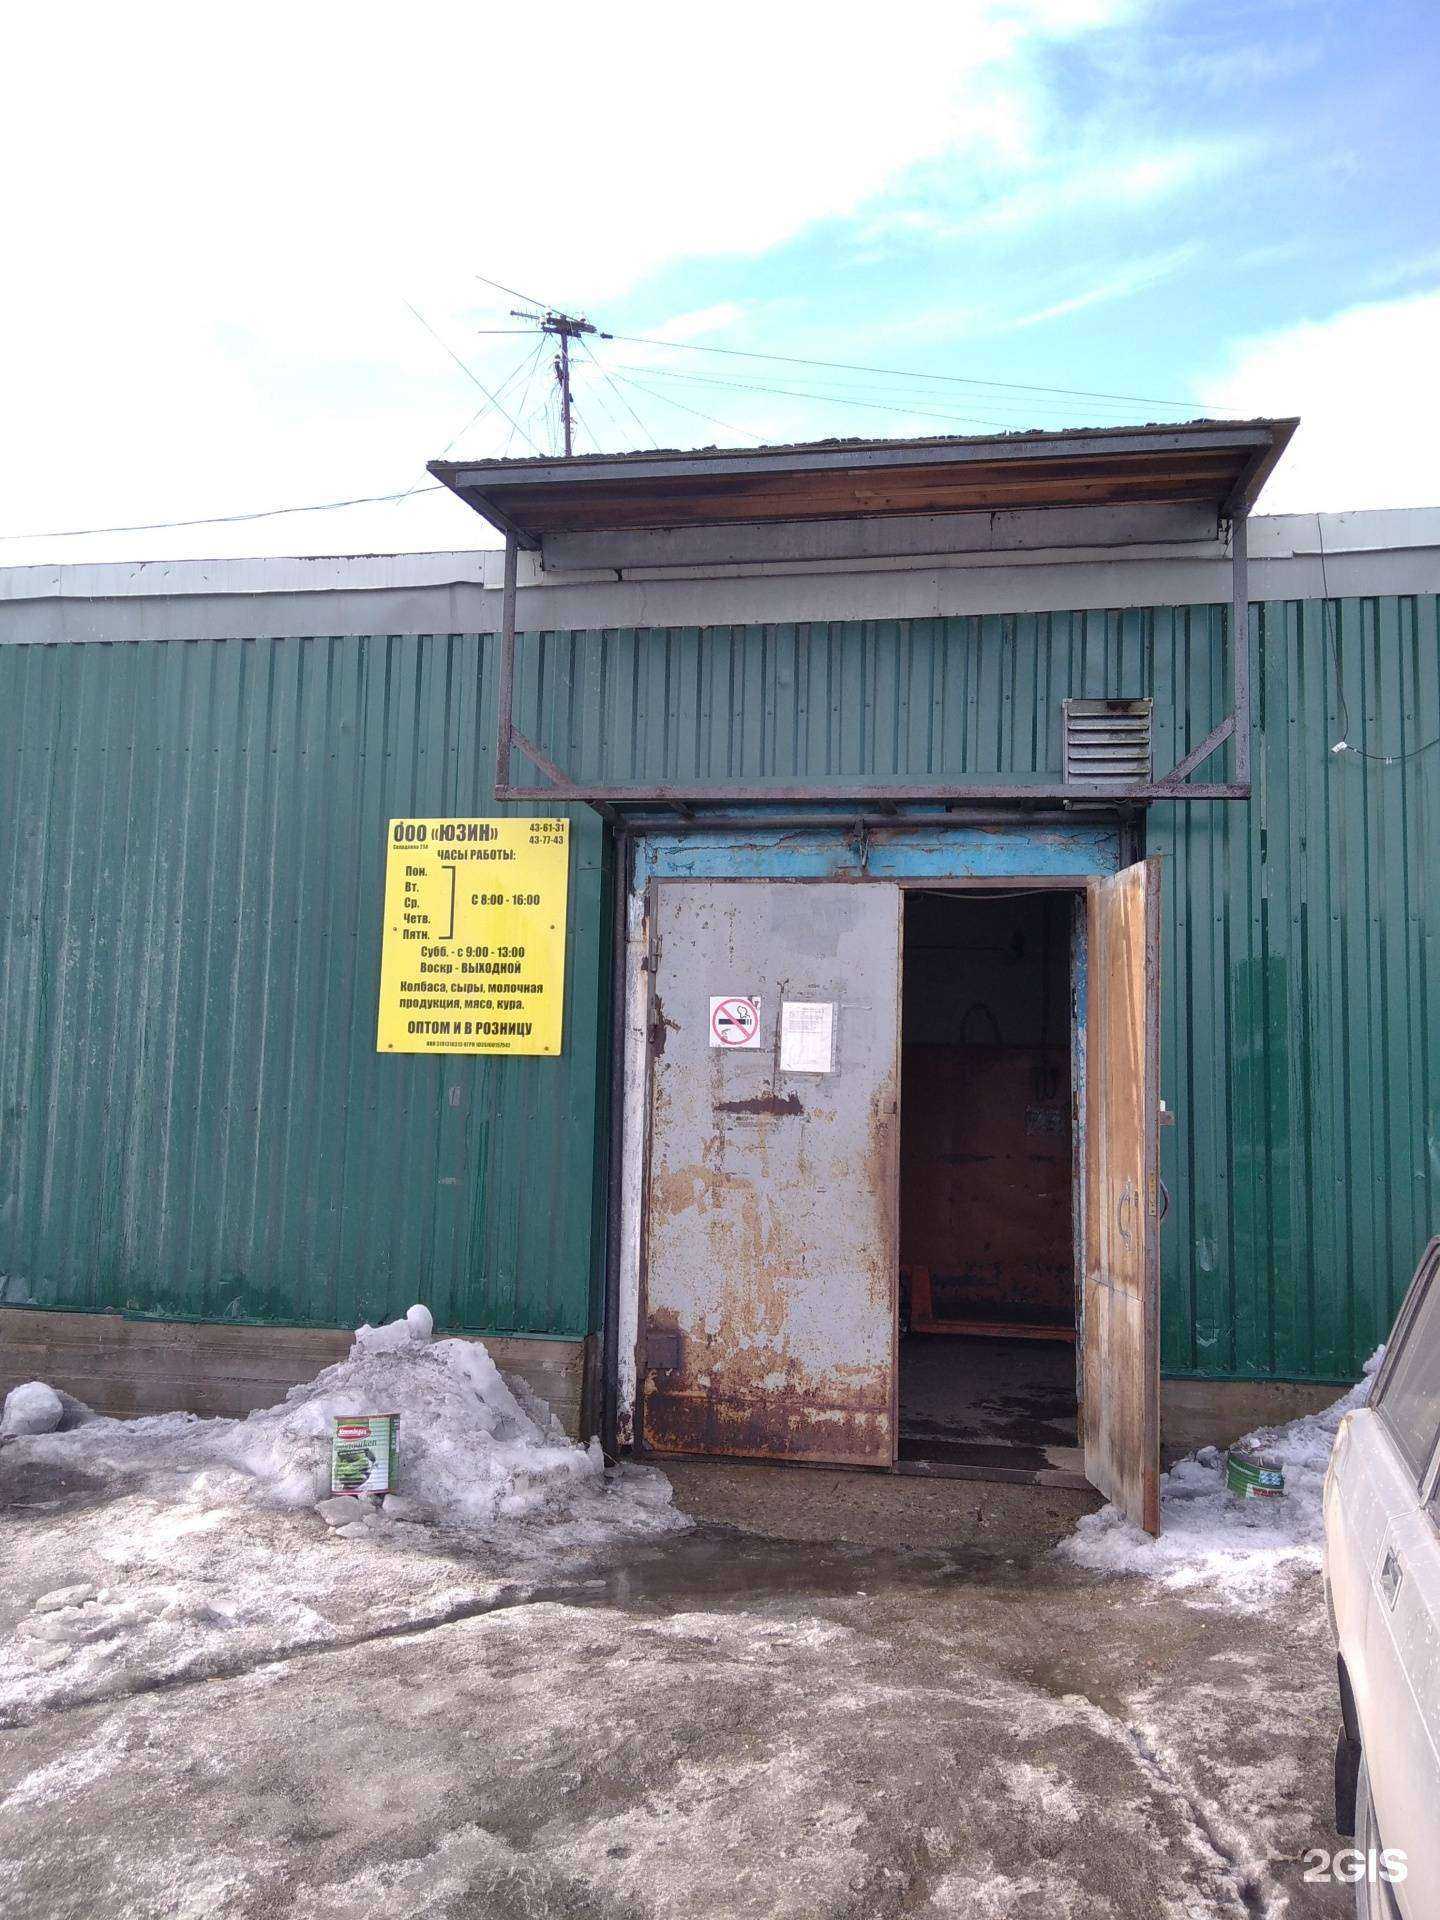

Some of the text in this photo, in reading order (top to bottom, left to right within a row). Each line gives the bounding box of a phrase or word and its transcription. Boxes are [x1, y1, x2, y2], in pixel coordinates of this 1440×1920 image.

[393, 823, 499, 842] ООО «ЮЗИН»
[528, 835, 564, 845] 43-77-43
[437, 849, 516, 861] ЧАСЫ РАБОТЫ:
[405, 865, 428, 877] Пон.
[404, 882, 420, 893] Вт.
[404, 897, 420, 909] Ср.
[480, 894, 504, 906] 8:00
[512, 894, 541, 906] 16:00
[403, 913, 432, 924] Четв.
[402, 929, 431, 940] Пятн.
[420, 946, 449, 959] Субб.
[466, 946, 489, 958] 9:00
[497, 947, 525, 958] 13:00
[420, 962, 453, 975] Воскр
[461, 961, 522, 976] ВЫХОДНОЙ
[400, 981, 544, 994] Колбаса, сыры, молочная
[399, 998, 525, 1011] продукция, мясо, кура.
[407, 1021, 533, 1037] ОПТОМ И В РОЗНИЦУ
